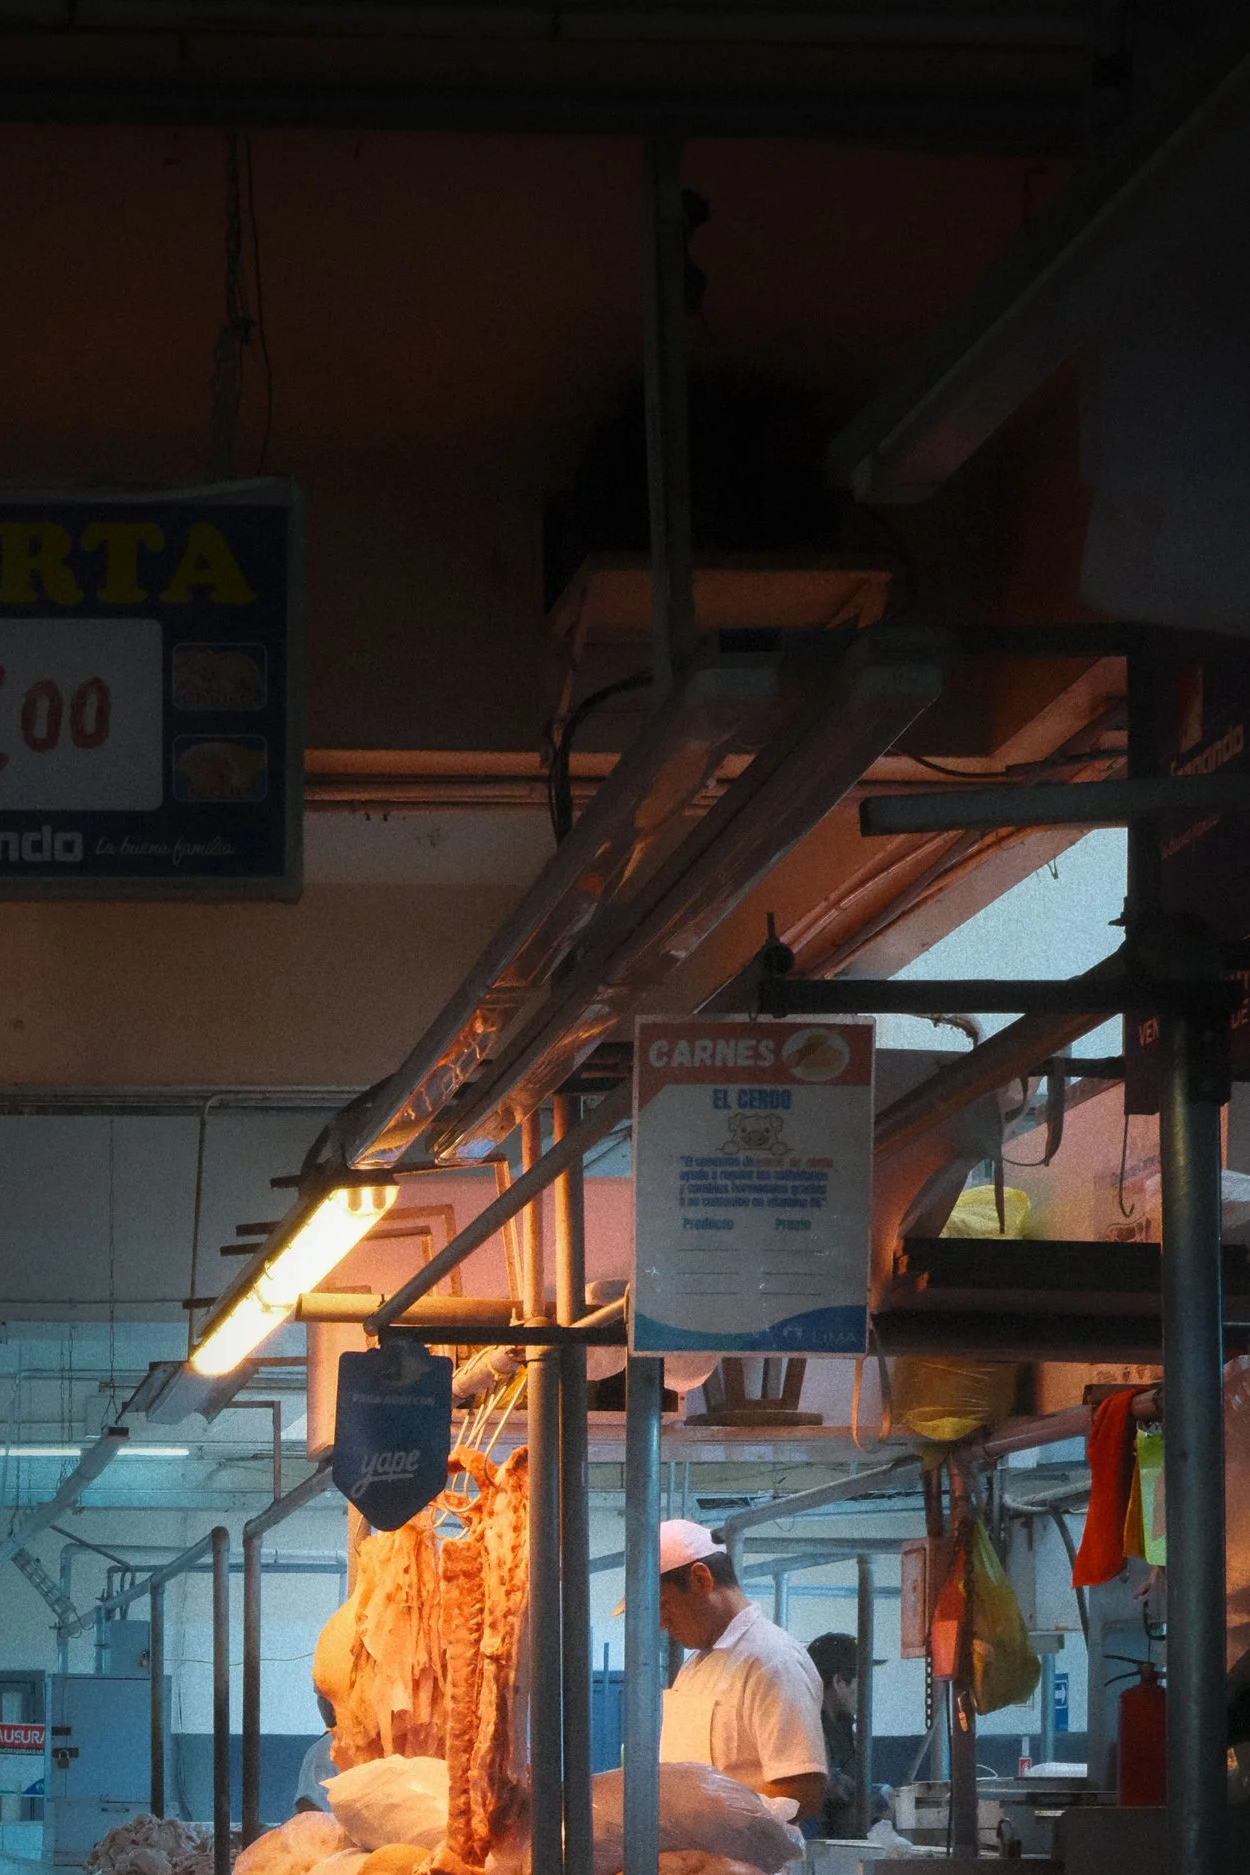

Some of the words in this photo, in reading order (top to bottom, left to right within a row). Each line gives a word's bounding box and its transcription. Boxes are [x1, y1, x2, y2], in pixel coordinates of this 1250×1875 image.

[649, 1039, 776, 1068] CARNES
[713, 1088, 732, 1110] EL
[811, 1330, 858, 1344] LIMA
[349, 1449, 422, 1499] yape
